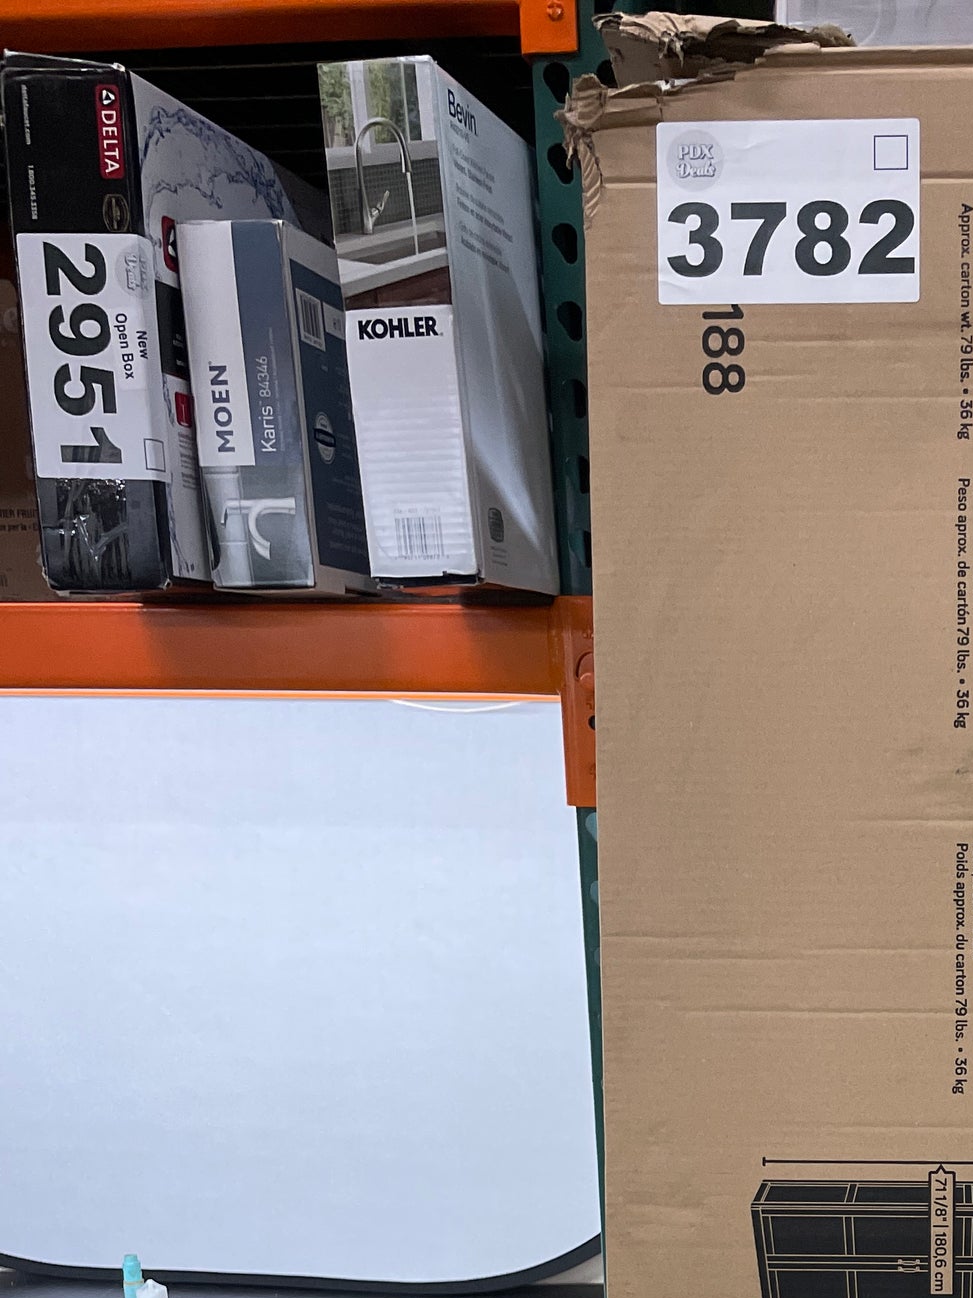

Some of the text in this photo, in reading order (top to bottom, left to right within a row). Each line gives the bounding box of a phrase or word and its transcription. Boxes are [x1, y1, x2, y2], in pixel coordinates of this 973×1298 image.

[101, 110, 120, 173] DELTA
[447, 88, 478, 136] Bevin
[675, 161, 716, 180] Deals
[677, 143, 715, 161] PDX
[666, 199, 916, 278] 3782
[42, 241, 123, 464] 2951
[114, 313, 136, 380] Open Box
[136, 330, 149, 360] New
[357, 316, 439, 340] KOHLER
[956, 203, 973, 441] Approx. carton wt. 79 lbs. 36 kg
[208, 364, 236, 454] MOEN
[258, 356, 278, 453] Karis 84346
[953, 478, 971, 729] Peso aprox. de cartón 79 lbs. 36 kg
[951, 843, 970, 1095] Poids approx. du carton 79 lbs. 36 kg
[932, 1178, 948, 1292] 71 1/8" 180,6 cm
